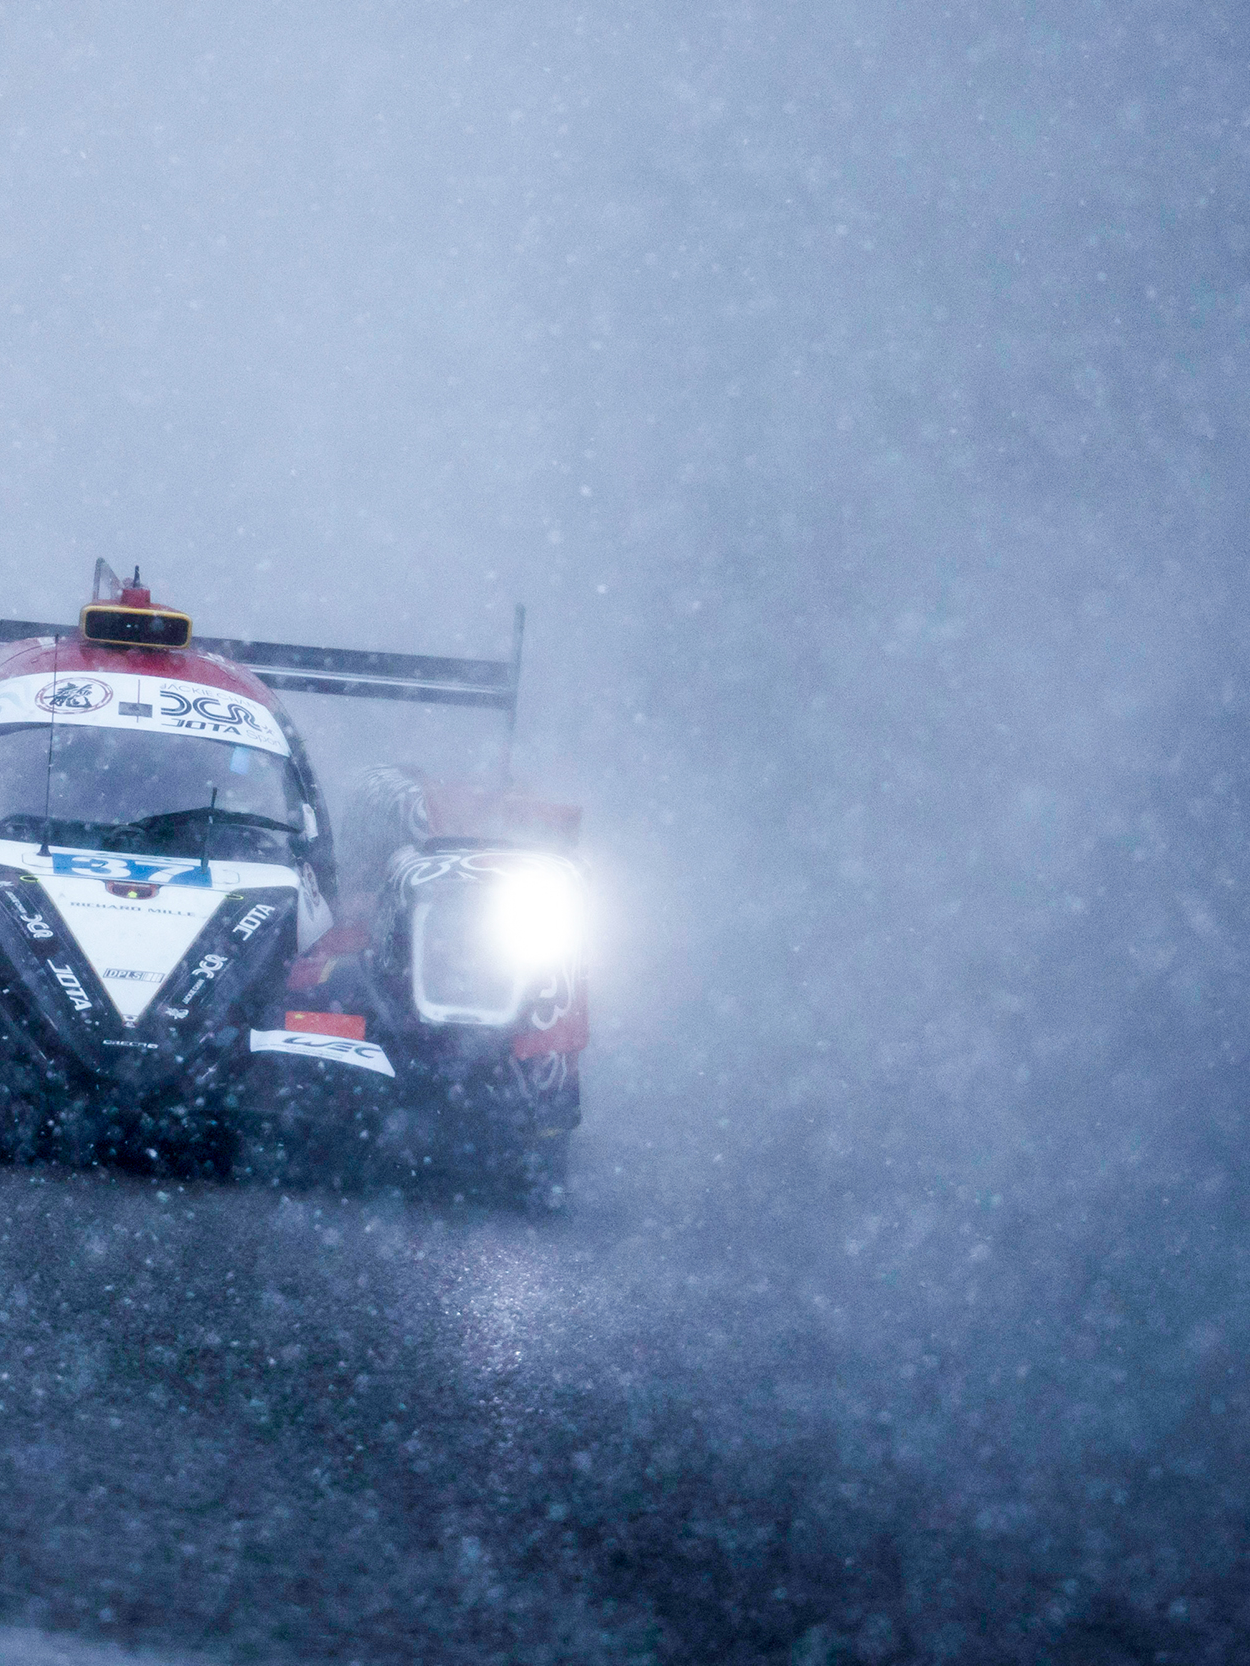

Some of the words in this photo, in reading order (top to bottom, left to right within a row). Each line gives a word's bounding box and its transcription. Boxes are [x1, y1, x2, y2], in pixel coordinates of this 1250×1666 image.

[160, 682, 213, 696] JACKIE
[161, 718, 241, 735] JOTA
[71, 856, 195, 883] 37
[70, 901, 141, 912] RICHARD
[148, 906, 197, 917] MILLE
[232, 904, 275, 941] JOTA
[47, 959, 92, 1011] JOTA
[282, 1036, 382, 1058] WEC
